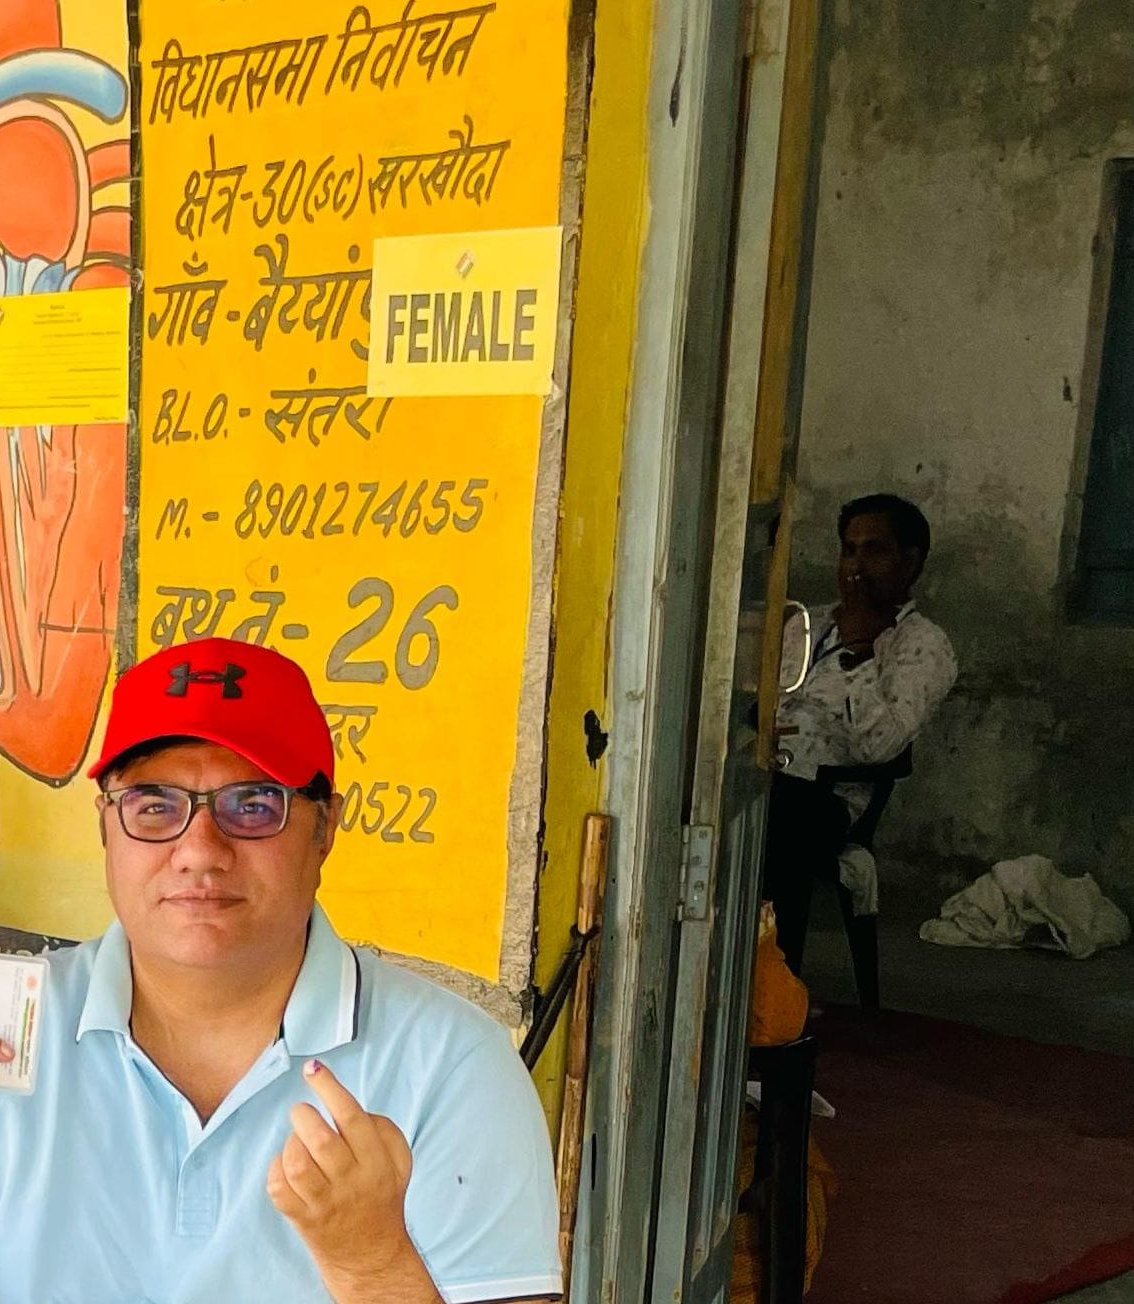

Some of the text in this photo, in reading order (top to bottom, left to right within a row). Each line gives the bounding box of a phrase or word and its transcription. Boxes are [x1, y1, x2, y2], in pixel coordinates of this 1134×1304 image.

[385, 288, 538, 364] FEMALE
[234, 478, 490, 540] 8901274655
[325, 577, 460, 691] 26
[339, 781, 437, 843] 0522
